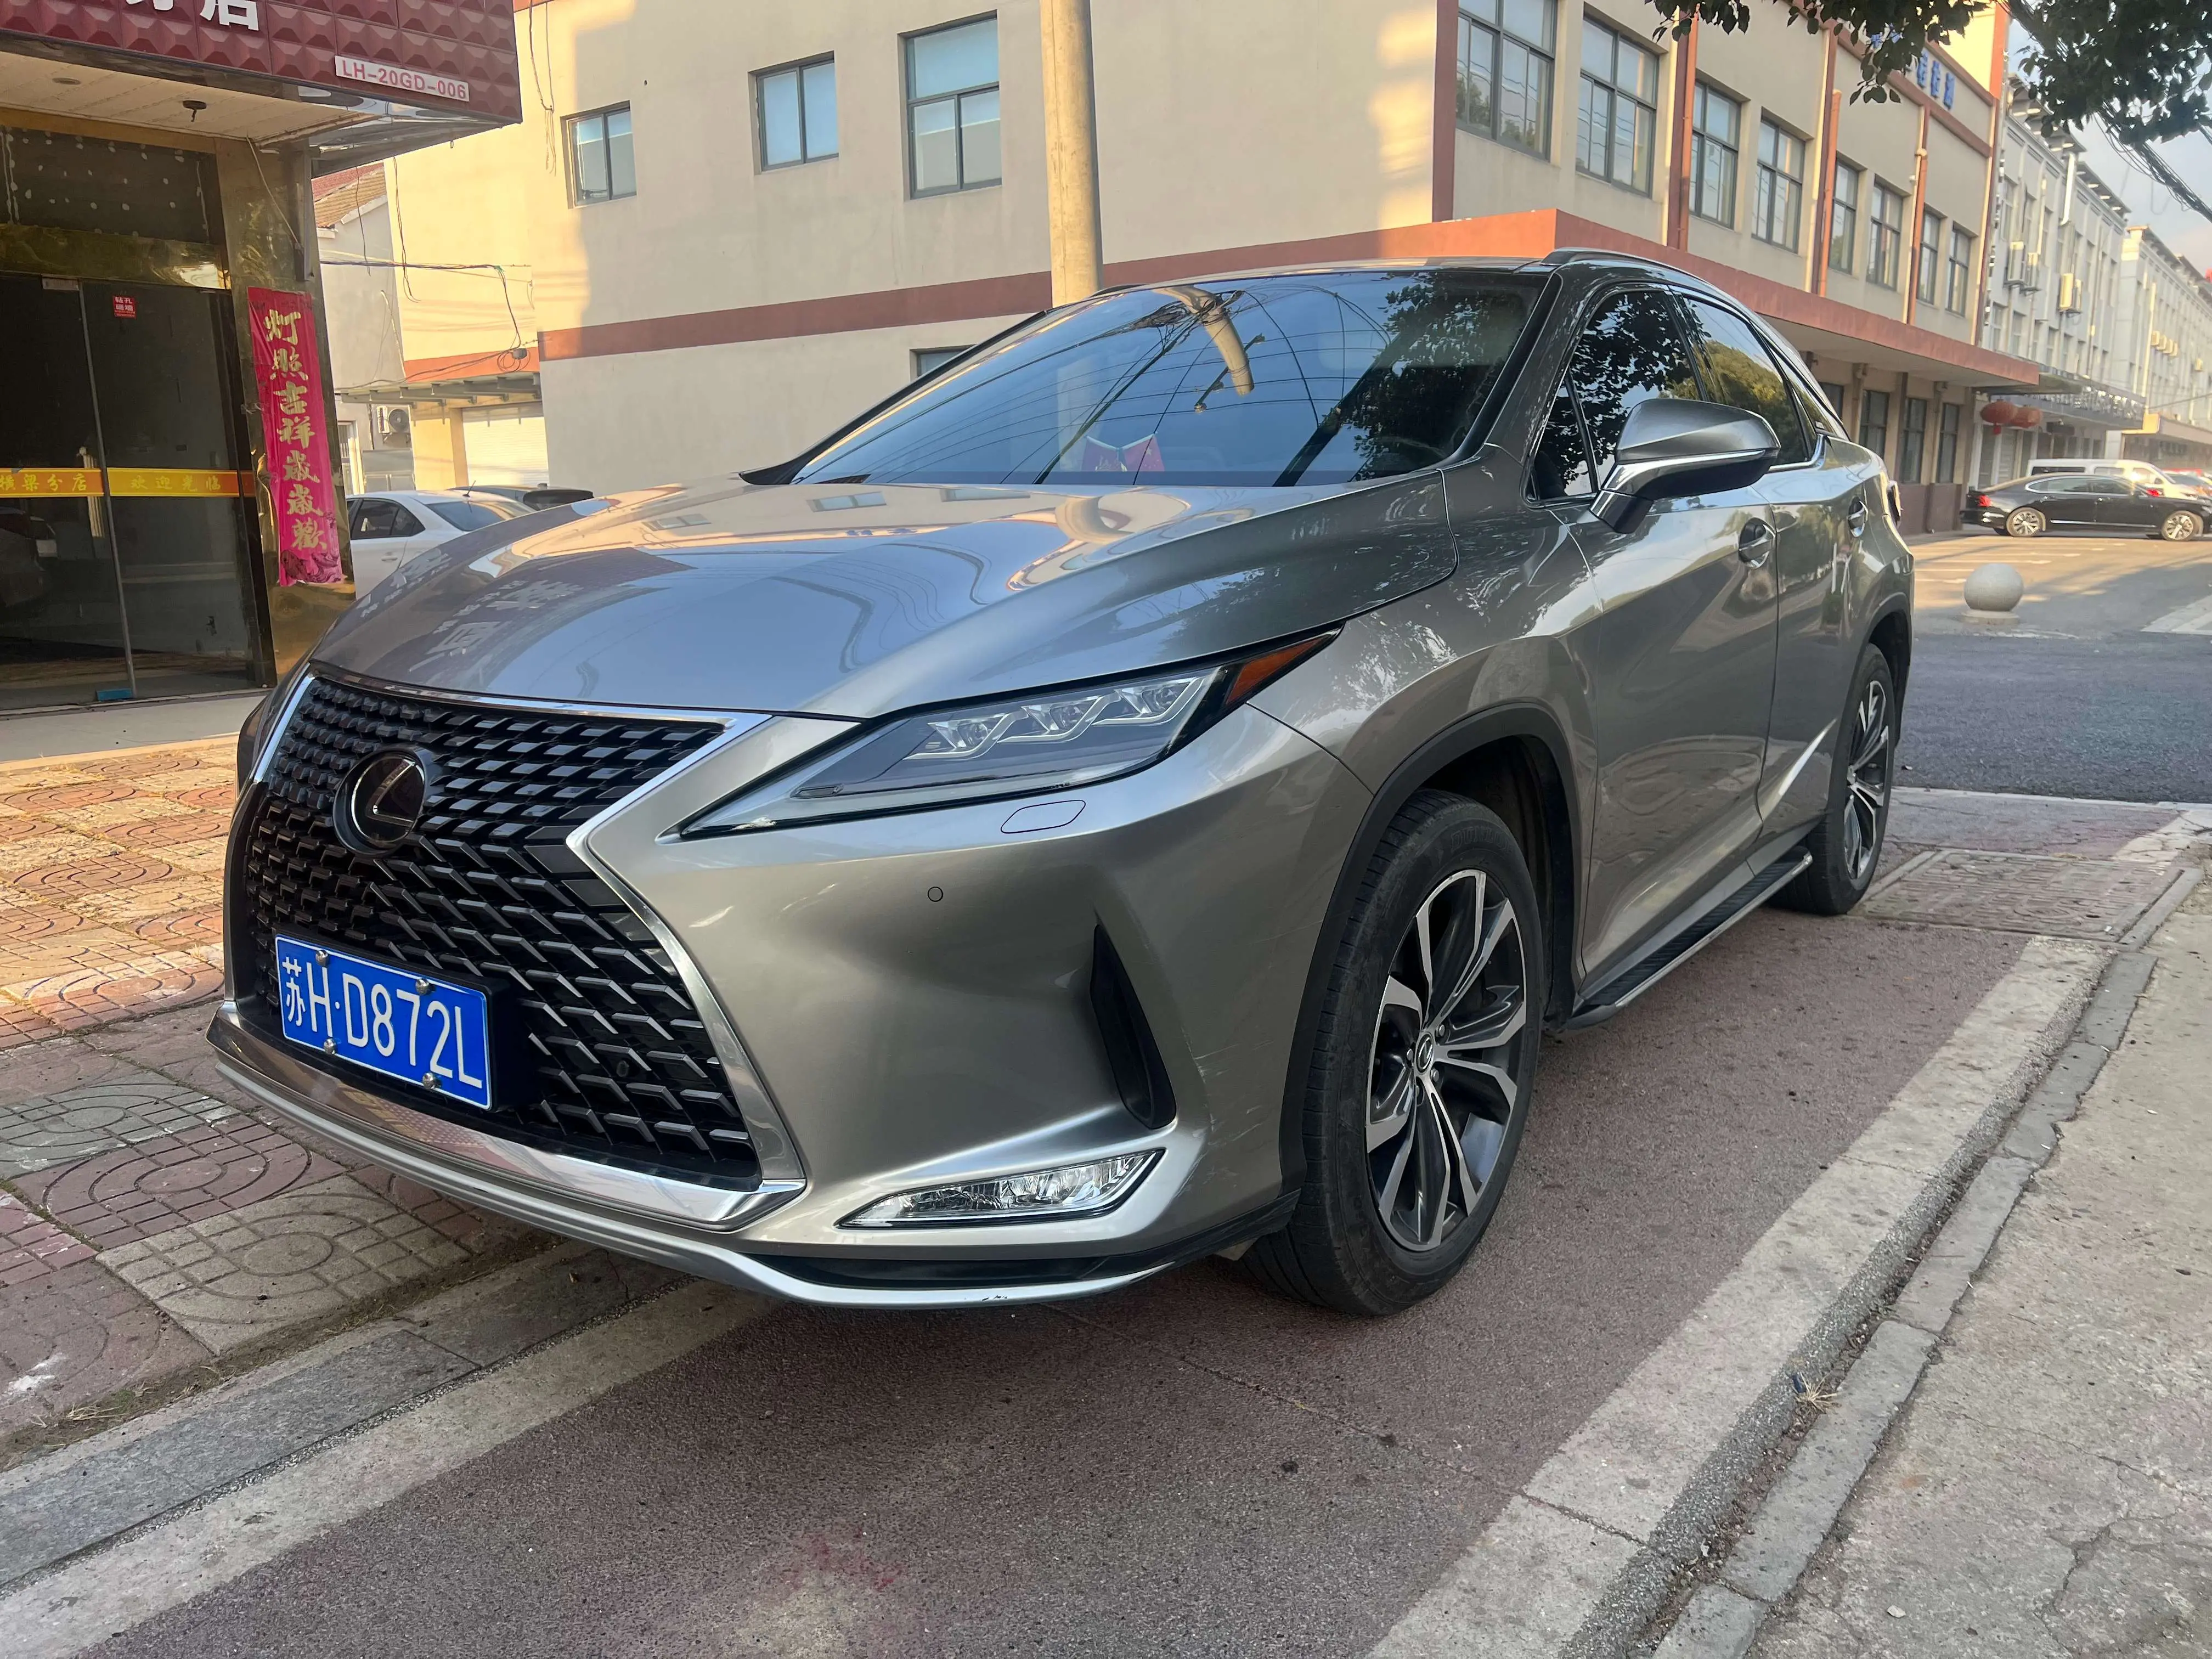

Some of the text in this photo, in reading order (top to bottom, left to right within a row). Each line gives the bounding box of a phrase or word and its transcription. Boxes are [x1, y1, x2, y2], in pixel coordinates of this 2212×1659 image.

[342, 60, 466, 99] LH-20GD-006
[131, 475, 221, 492] 欢迎光临
